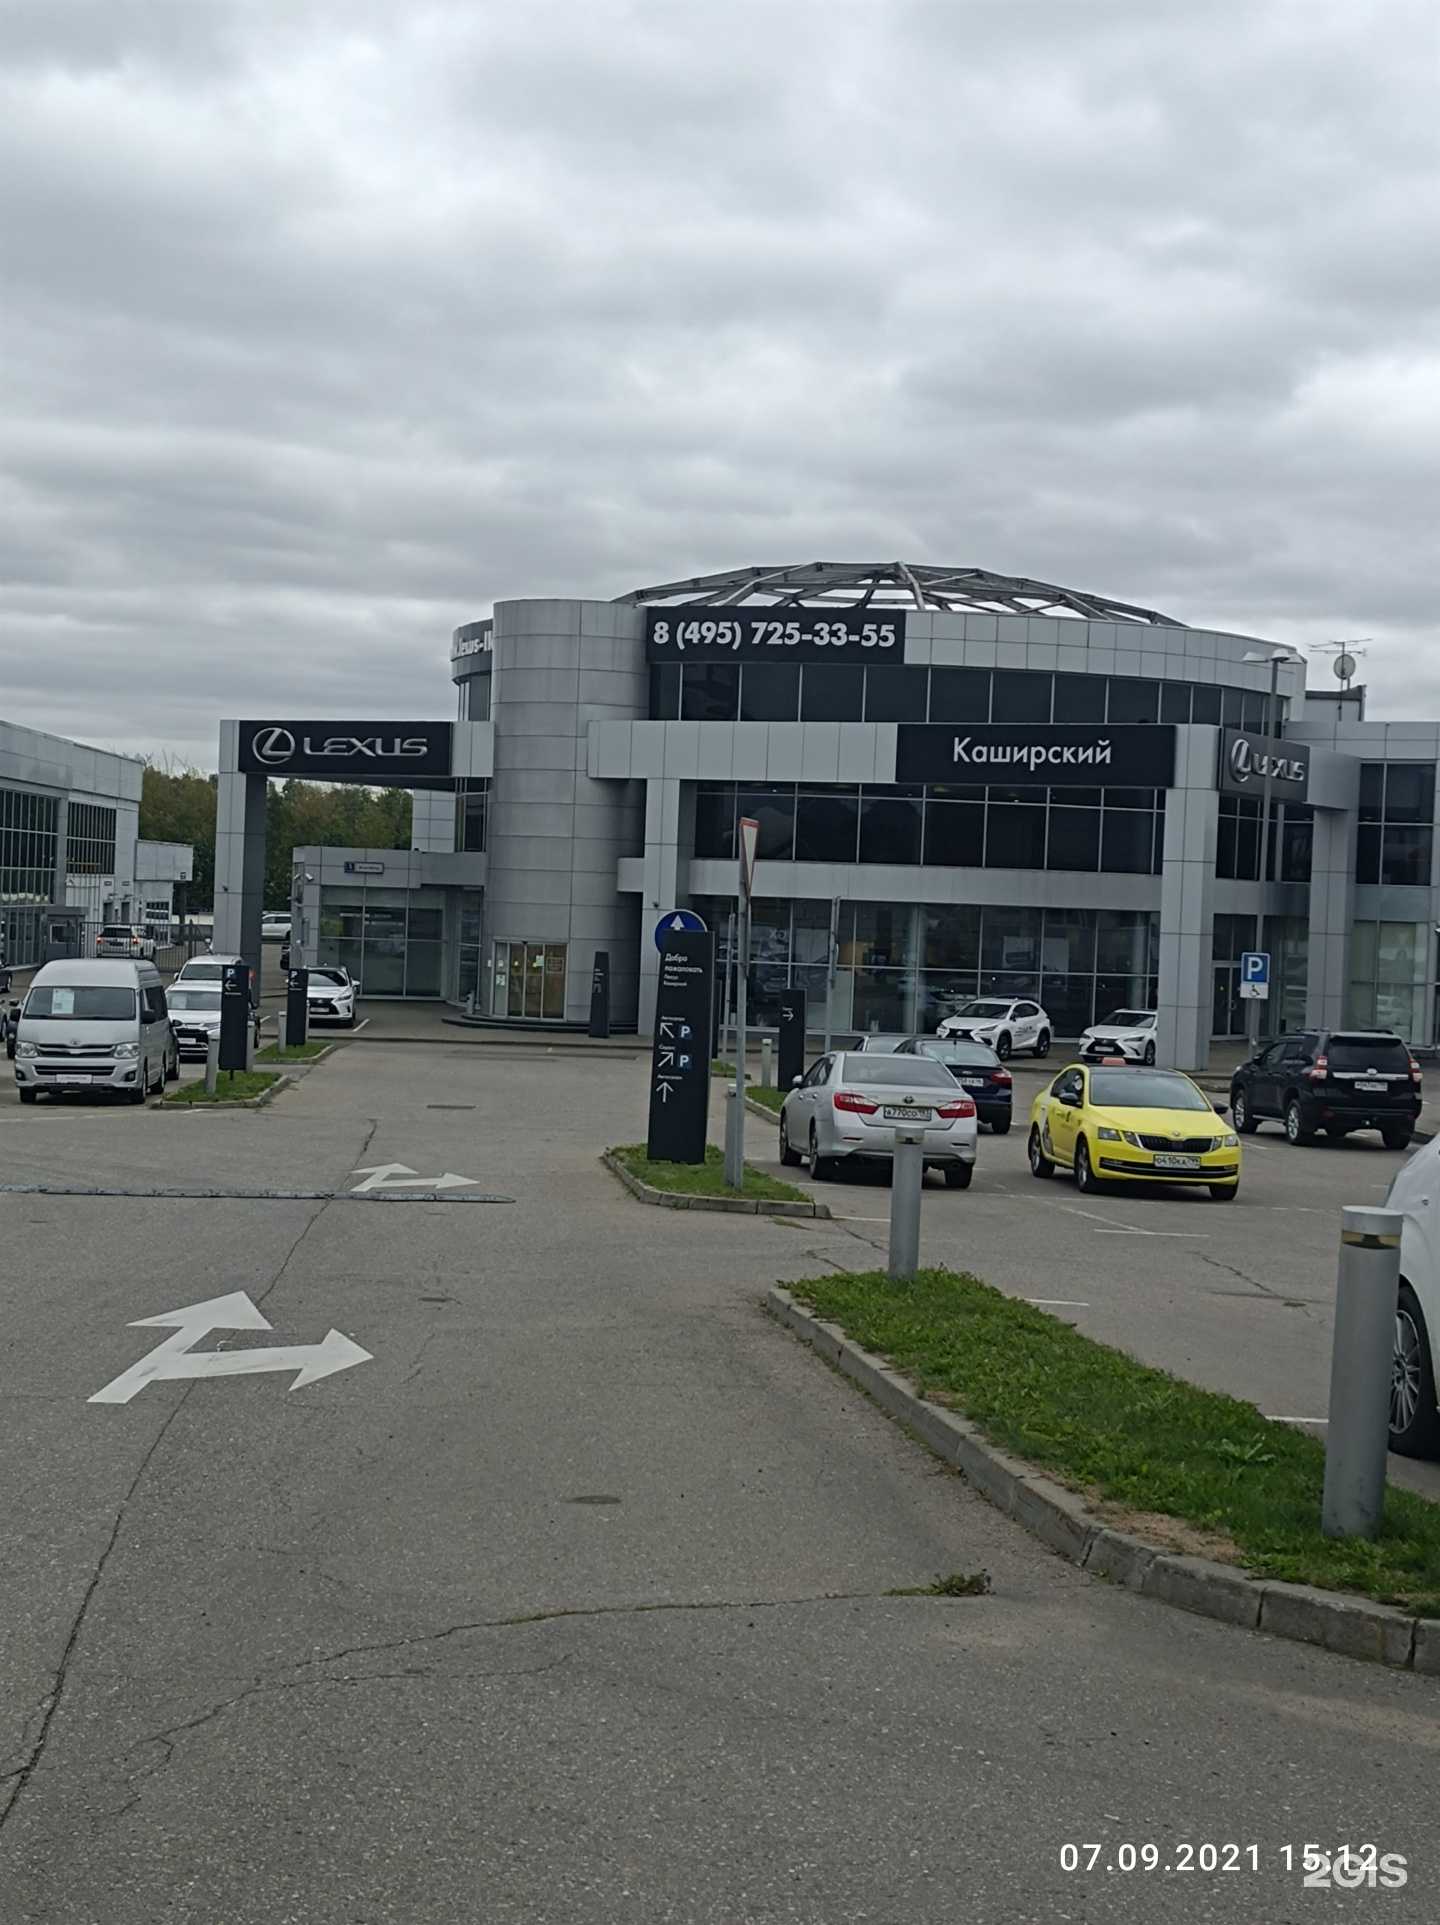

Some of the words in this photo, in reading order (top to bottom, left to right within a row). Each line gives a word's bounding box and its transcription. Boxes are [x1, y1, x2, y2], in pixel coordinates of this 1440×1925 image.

[653, 622, 669, 644] 8
[676, 621, 742, 650] (495)
[751, 622, 895, 647] 725-33-55
[303, 737, 428, 757] LEXUS
[953, 737, 1111, 771] Каширский
[1247, 956, 1264, 980] P
[680, 1025, 691, 1038] P
[679, 1055, 690, 1068] P
